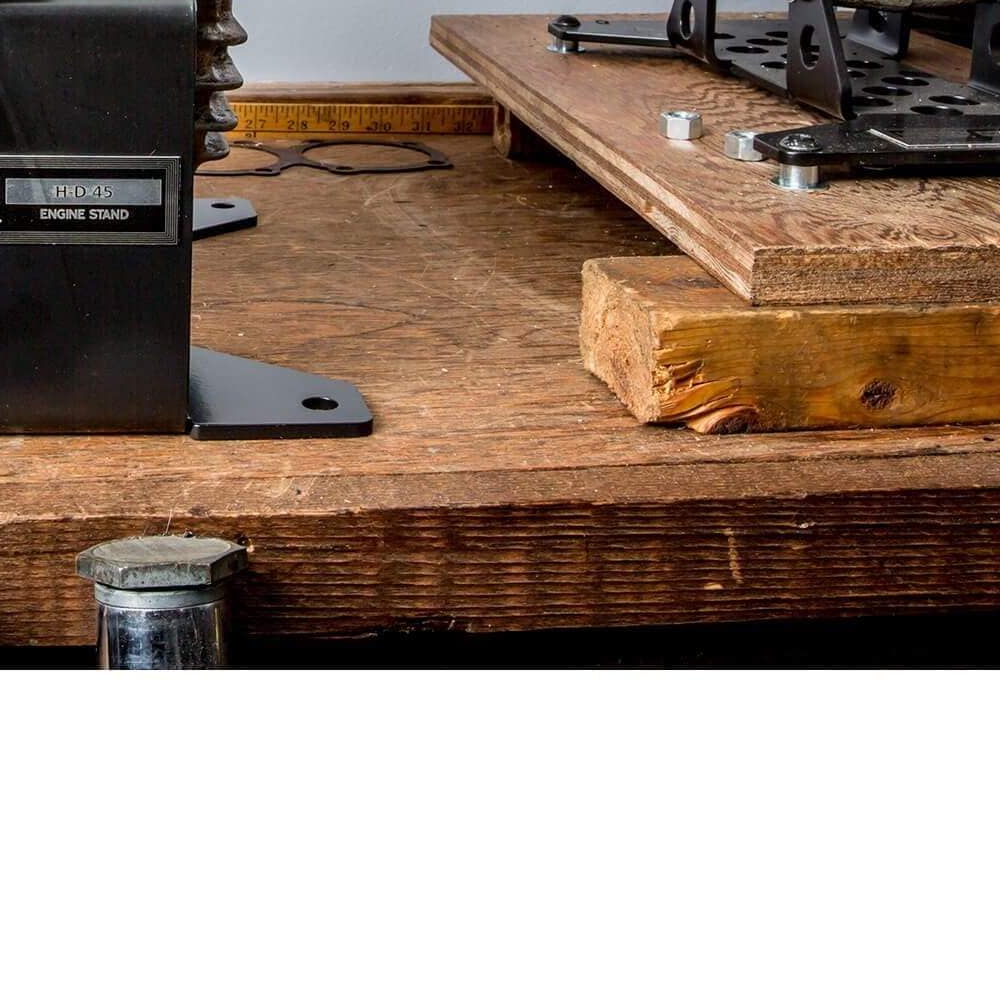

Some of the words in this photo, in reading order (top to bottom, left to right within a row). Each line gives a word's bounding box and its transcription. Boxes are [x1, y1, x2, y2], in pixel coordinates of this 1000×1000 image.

[92, 185, 114, 199] 45
[40, 208, 86, 220] ENGINE
[89, 208, 130, 220] STAND
